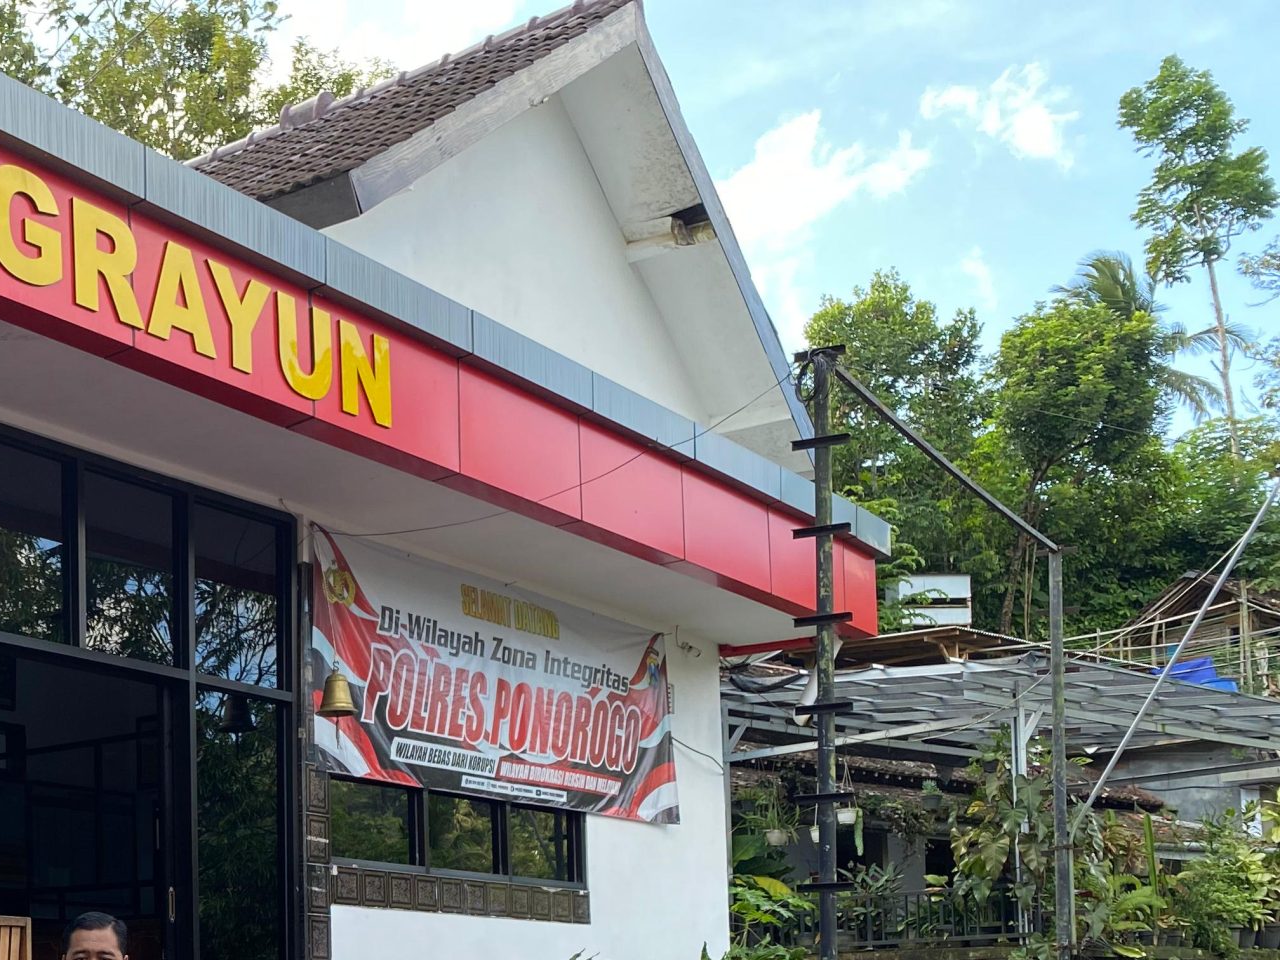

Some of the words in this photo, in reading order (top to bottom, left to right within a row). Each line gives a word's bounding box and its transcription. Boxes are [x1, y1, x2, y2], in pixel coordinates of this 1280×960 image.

[490, 636, 537, 671] Zona
[544, 650, 630, 694] Integritas
[362, 645, 488, 744] POLRES
[490, 677, 640, 773] PONOROGO
[395, 742, 429, 761] WILAYAH
[427, 747, 452, 766] BEBAS
[451, 752, 469, 769] DARI
[467, 754, 496, 775] KORUPSI
